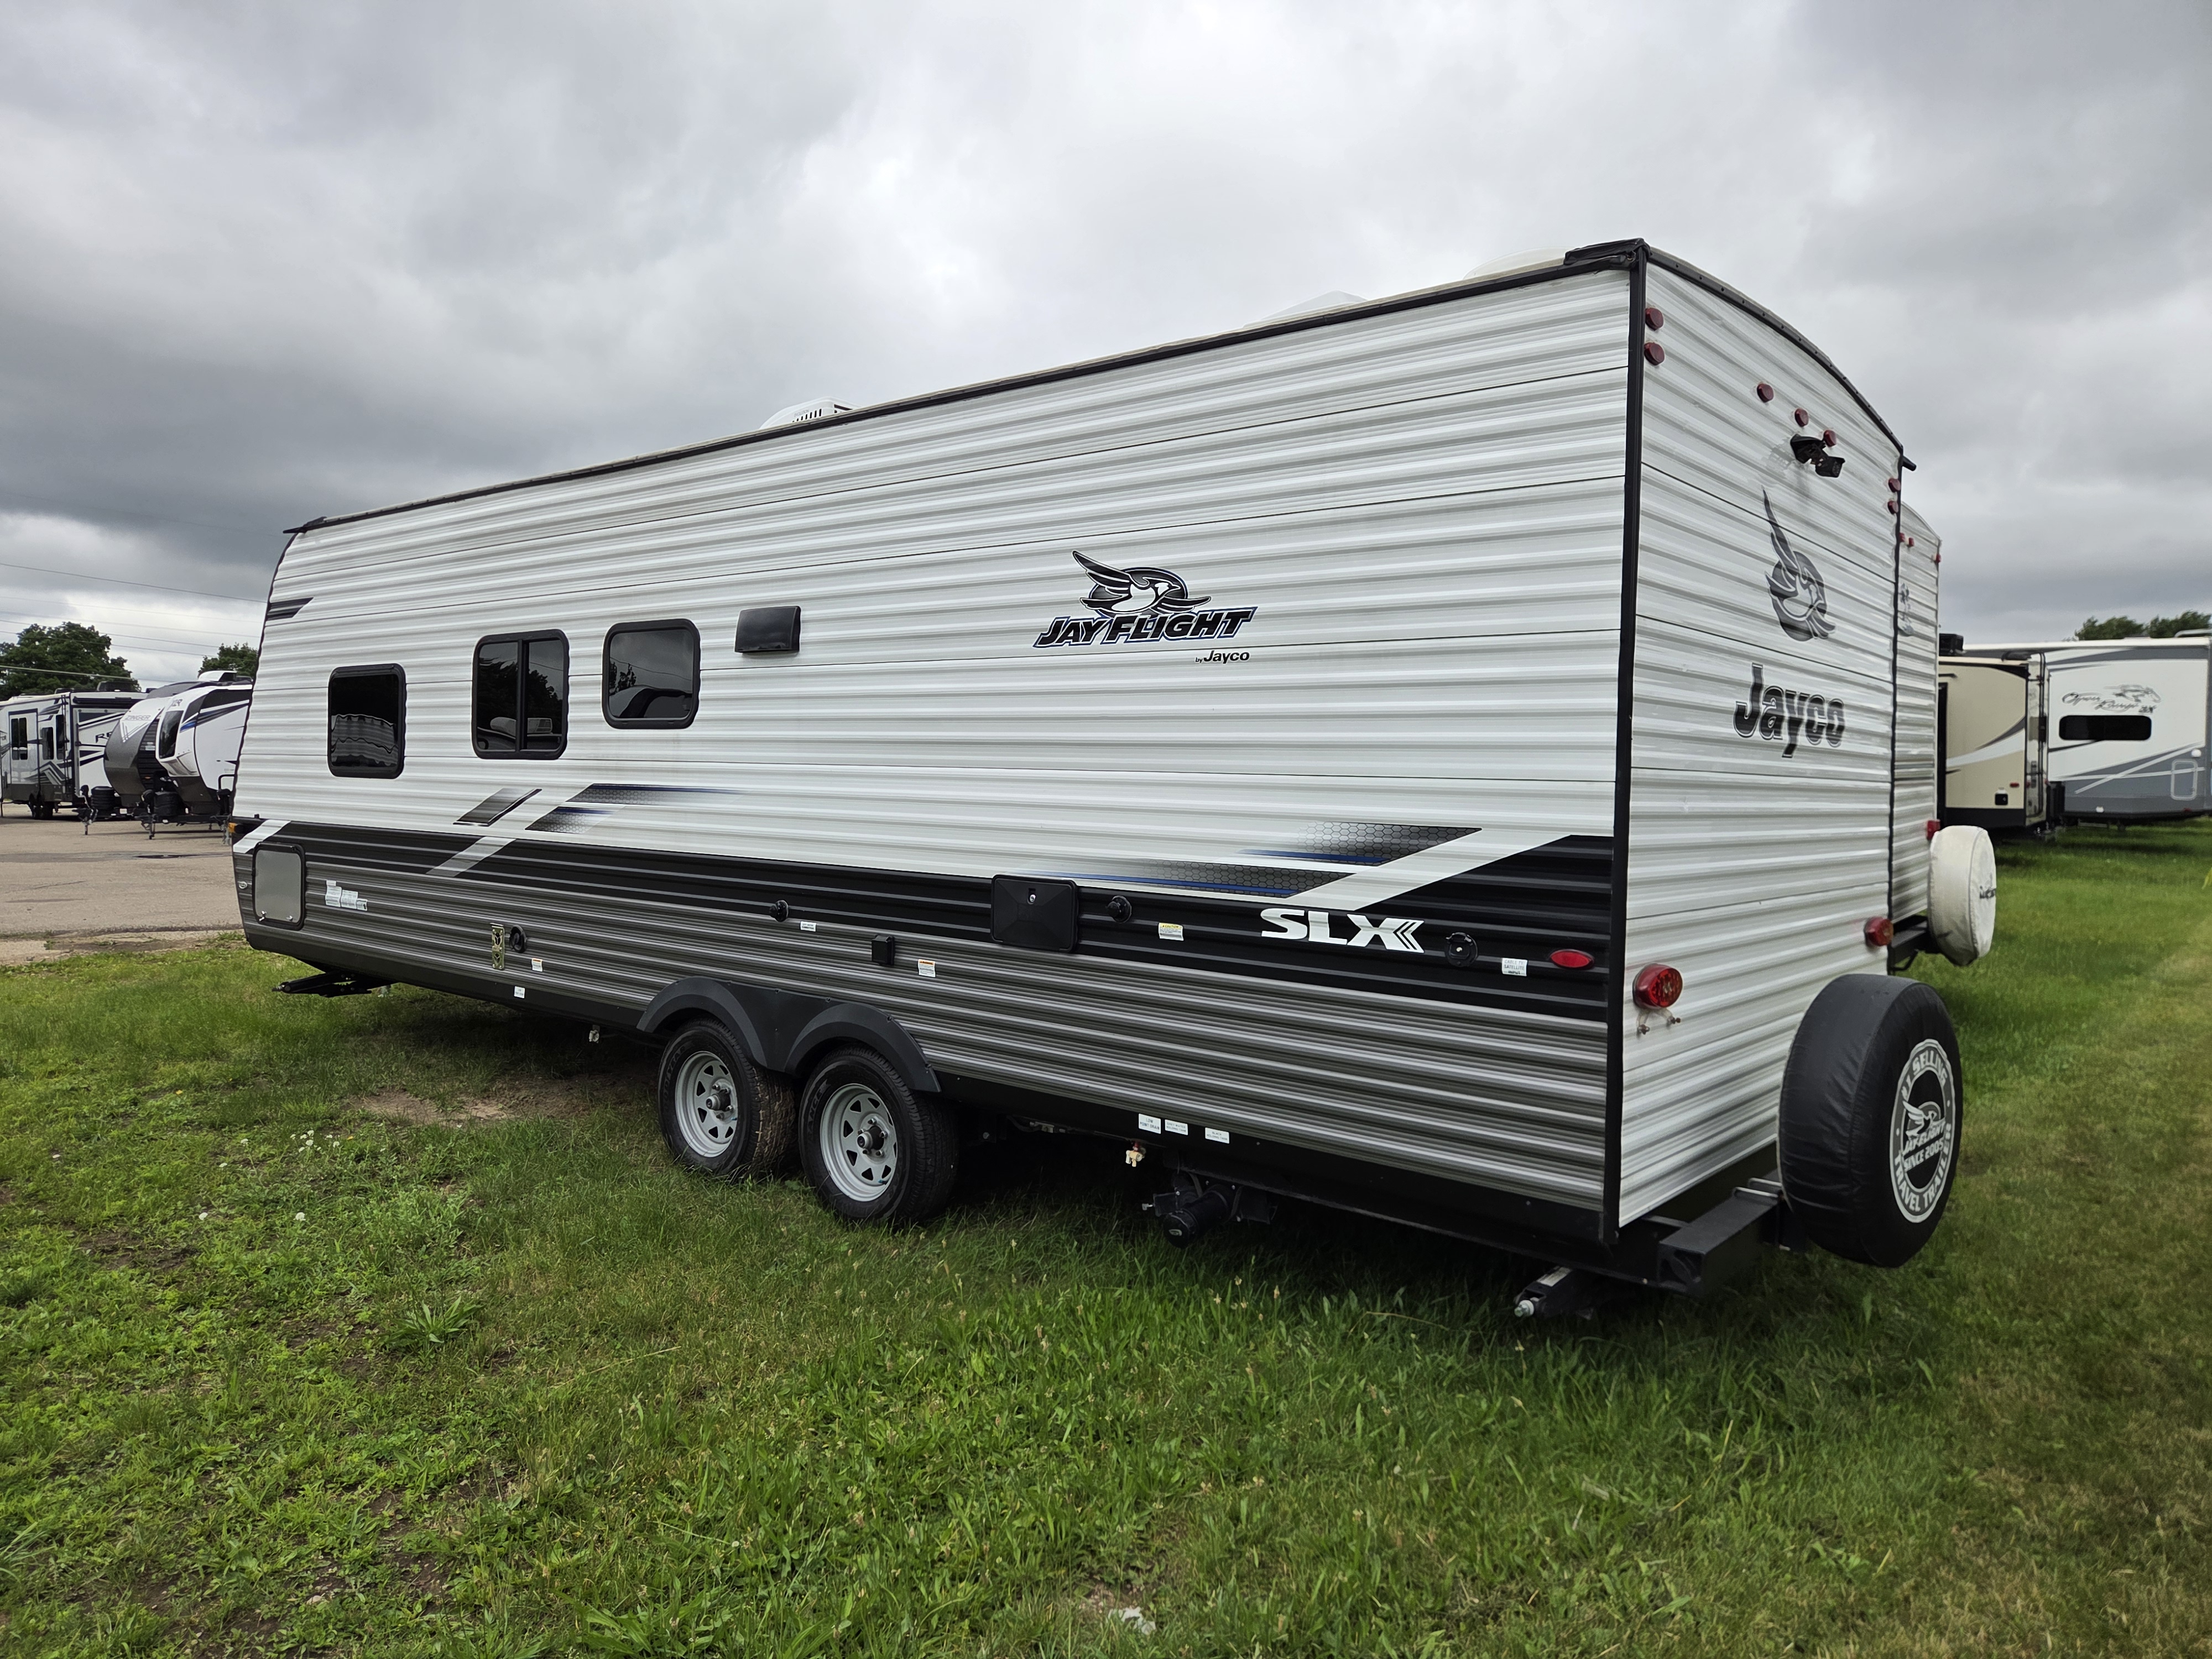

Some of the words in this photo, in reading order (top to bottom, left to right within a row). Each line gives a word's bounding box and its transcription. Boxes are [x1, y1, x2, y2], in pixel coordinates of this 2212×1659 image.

[1033, 617, 1108, 648] JAY
[1101, 607, 1258, 644] FLIGHT
[1203, 650, 1250, 664] Jayco
[1734, 662, 1845, 758] Jayco
[1260, 908, 1425, 953] SLX
[1912, 1050, 1948, 1088] SELLING
[1895, 1150, 1921, 1212] TRAVEL
[1903, 1149, 1925, 1172] SINCE
